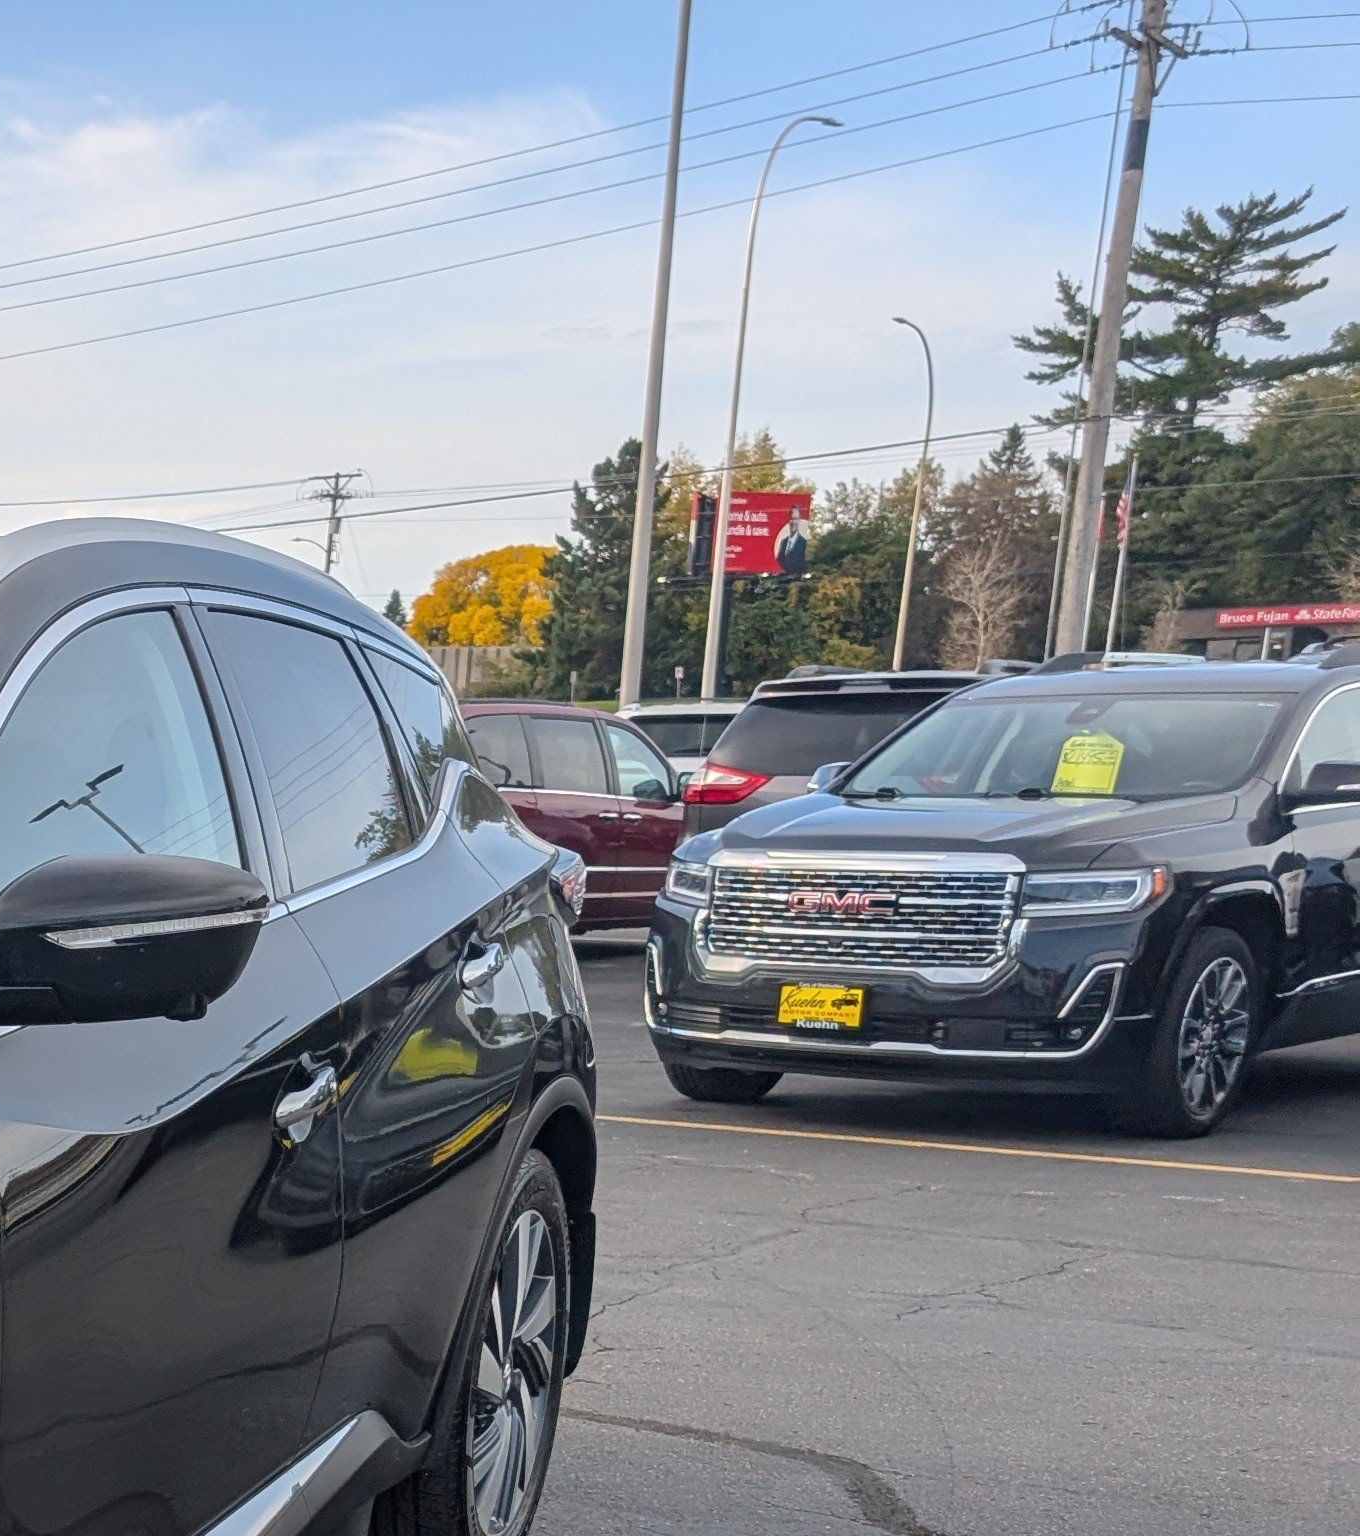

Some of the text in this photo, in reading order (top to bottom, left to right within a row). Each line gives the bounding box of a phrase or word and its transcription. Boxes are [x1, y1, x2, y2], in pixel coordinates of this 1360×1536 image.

[1219, 613, 1254, 624] Bruce
[788, 891, 897, 916] GMC
[779, 988, 827, 1009] Kuehn
[795, 1019, 840, 1030] Kuehn
